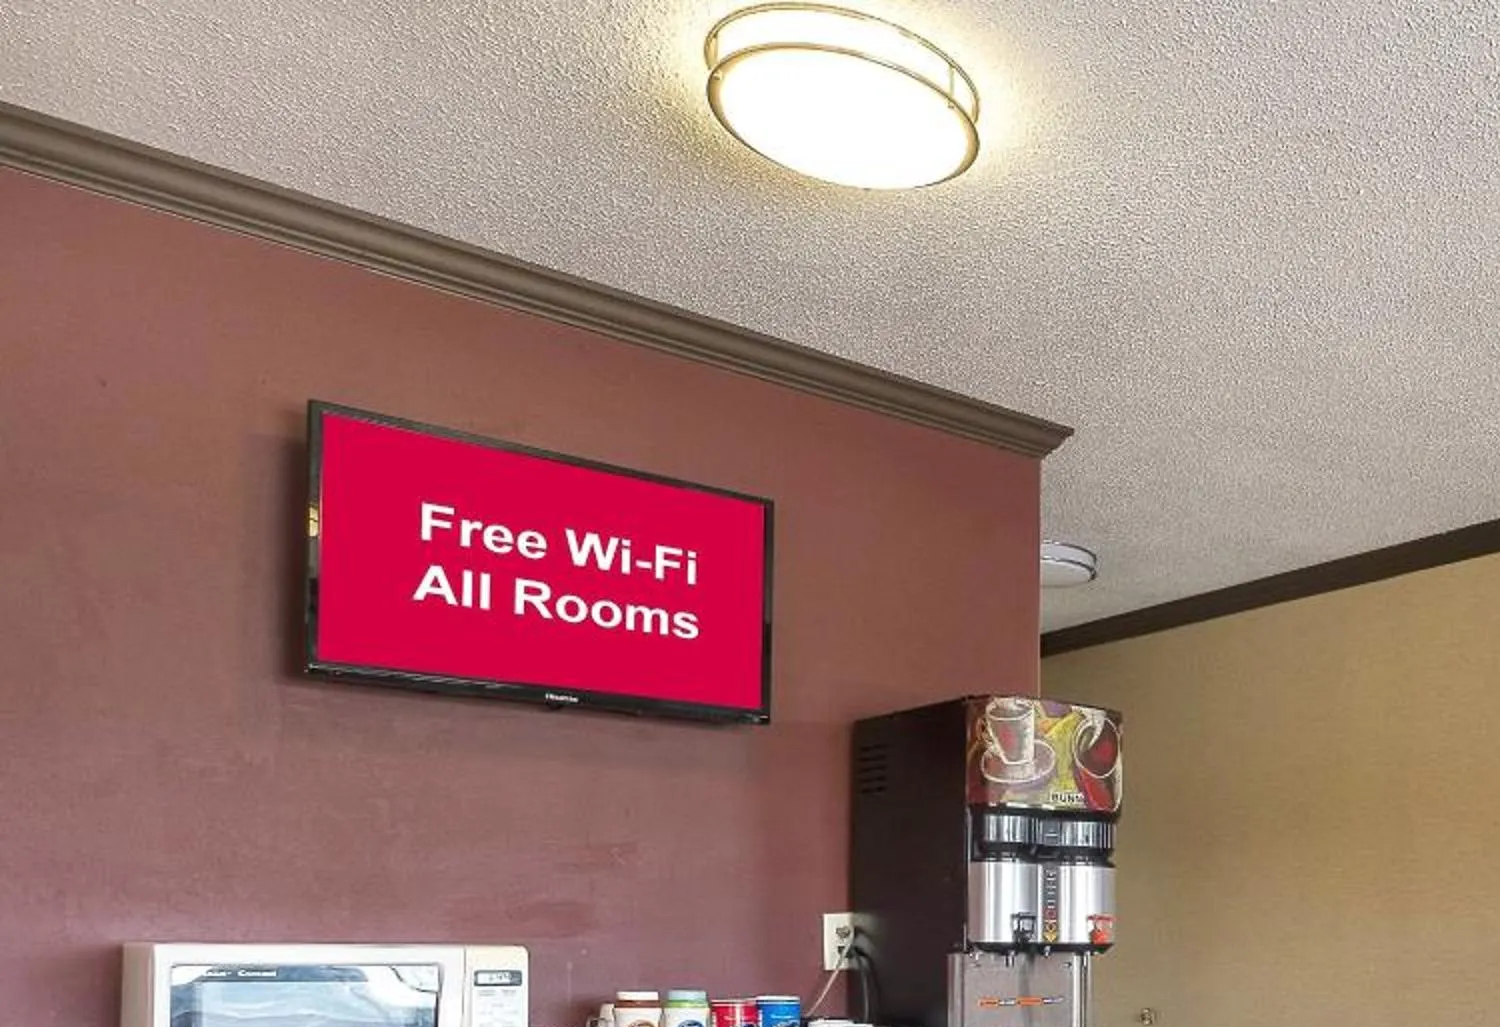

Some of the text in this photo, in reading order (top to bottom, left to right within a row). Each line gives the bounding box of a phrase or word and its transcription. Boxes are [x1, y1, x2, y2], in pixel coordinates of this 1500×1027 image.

[419, 501, 699, 586] Free Wi-Fi
[412, 564, 700, 640] All Rooms
